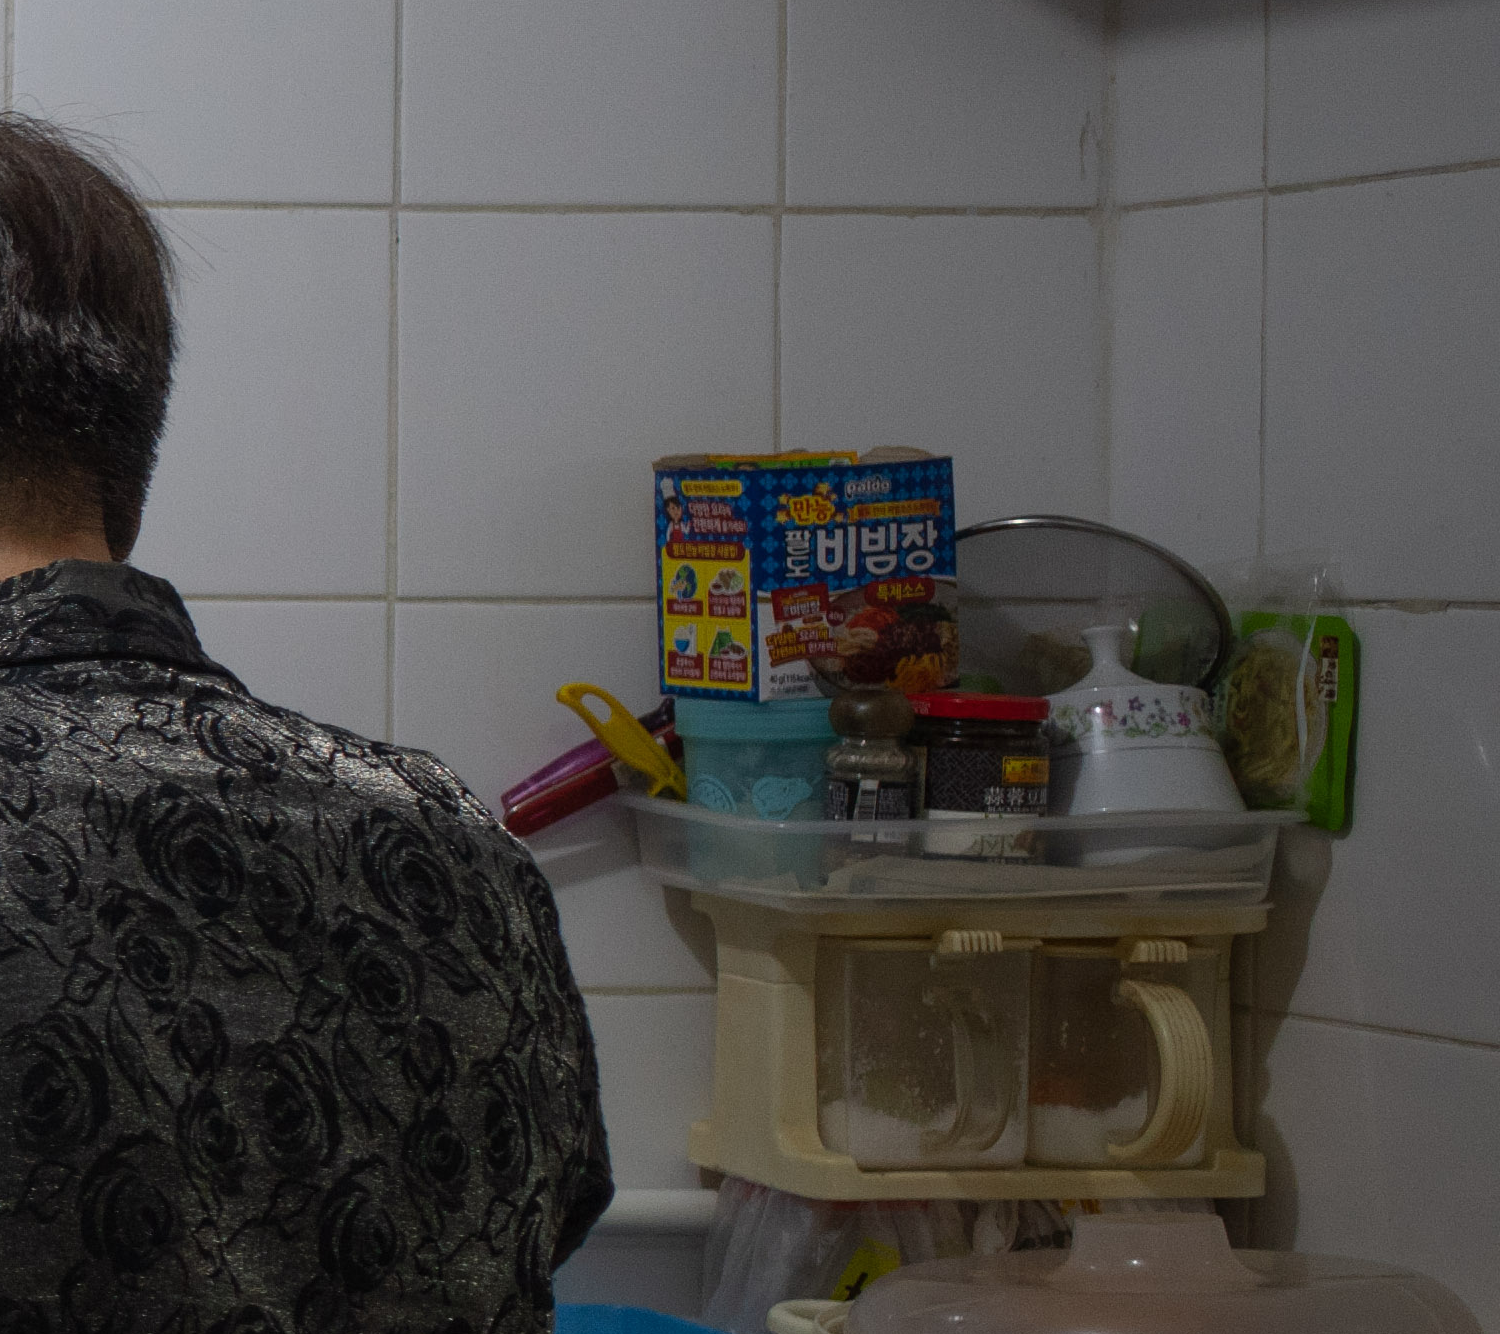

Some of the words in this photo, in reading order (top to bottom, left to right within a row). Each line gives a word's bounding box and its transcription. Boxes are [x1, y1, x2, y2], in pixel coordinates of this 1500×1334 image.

[845, 477, 892, 499] paldo
[792, 499, 833, 524] 만능
[784, 529, 812, 578] 팔도
[815, 520, 939, 577] 비빔장
[876, 583, 927, 602] 특제소스
